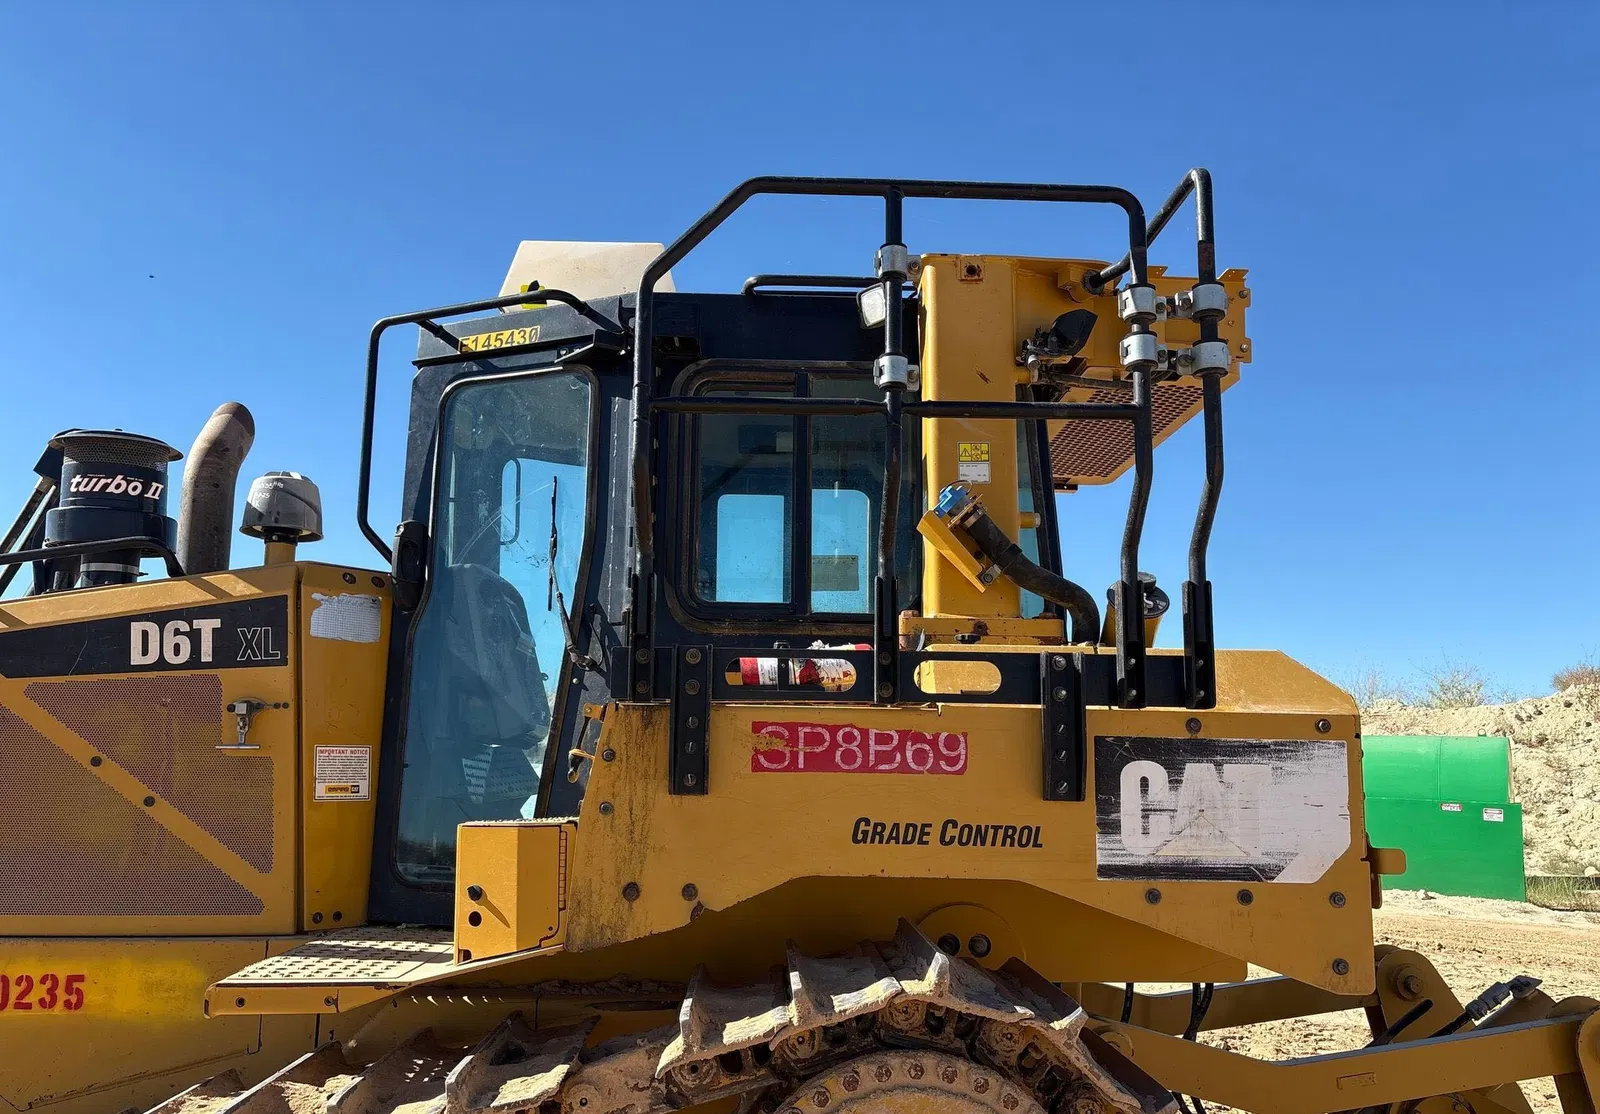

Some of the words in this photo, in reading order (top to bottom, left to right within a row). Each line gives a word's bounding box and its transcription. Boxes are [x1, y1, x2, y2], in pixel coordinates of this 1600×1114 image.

[69, 474, 143, 496] turbo
[144, 482, 164, 500] II
[131, 618, 222, 666] D6T
[237, 627, 281, 661] XL
[757, 725, 966, 772] SP8B69
[1120, 760, 1272, 857] CAT
